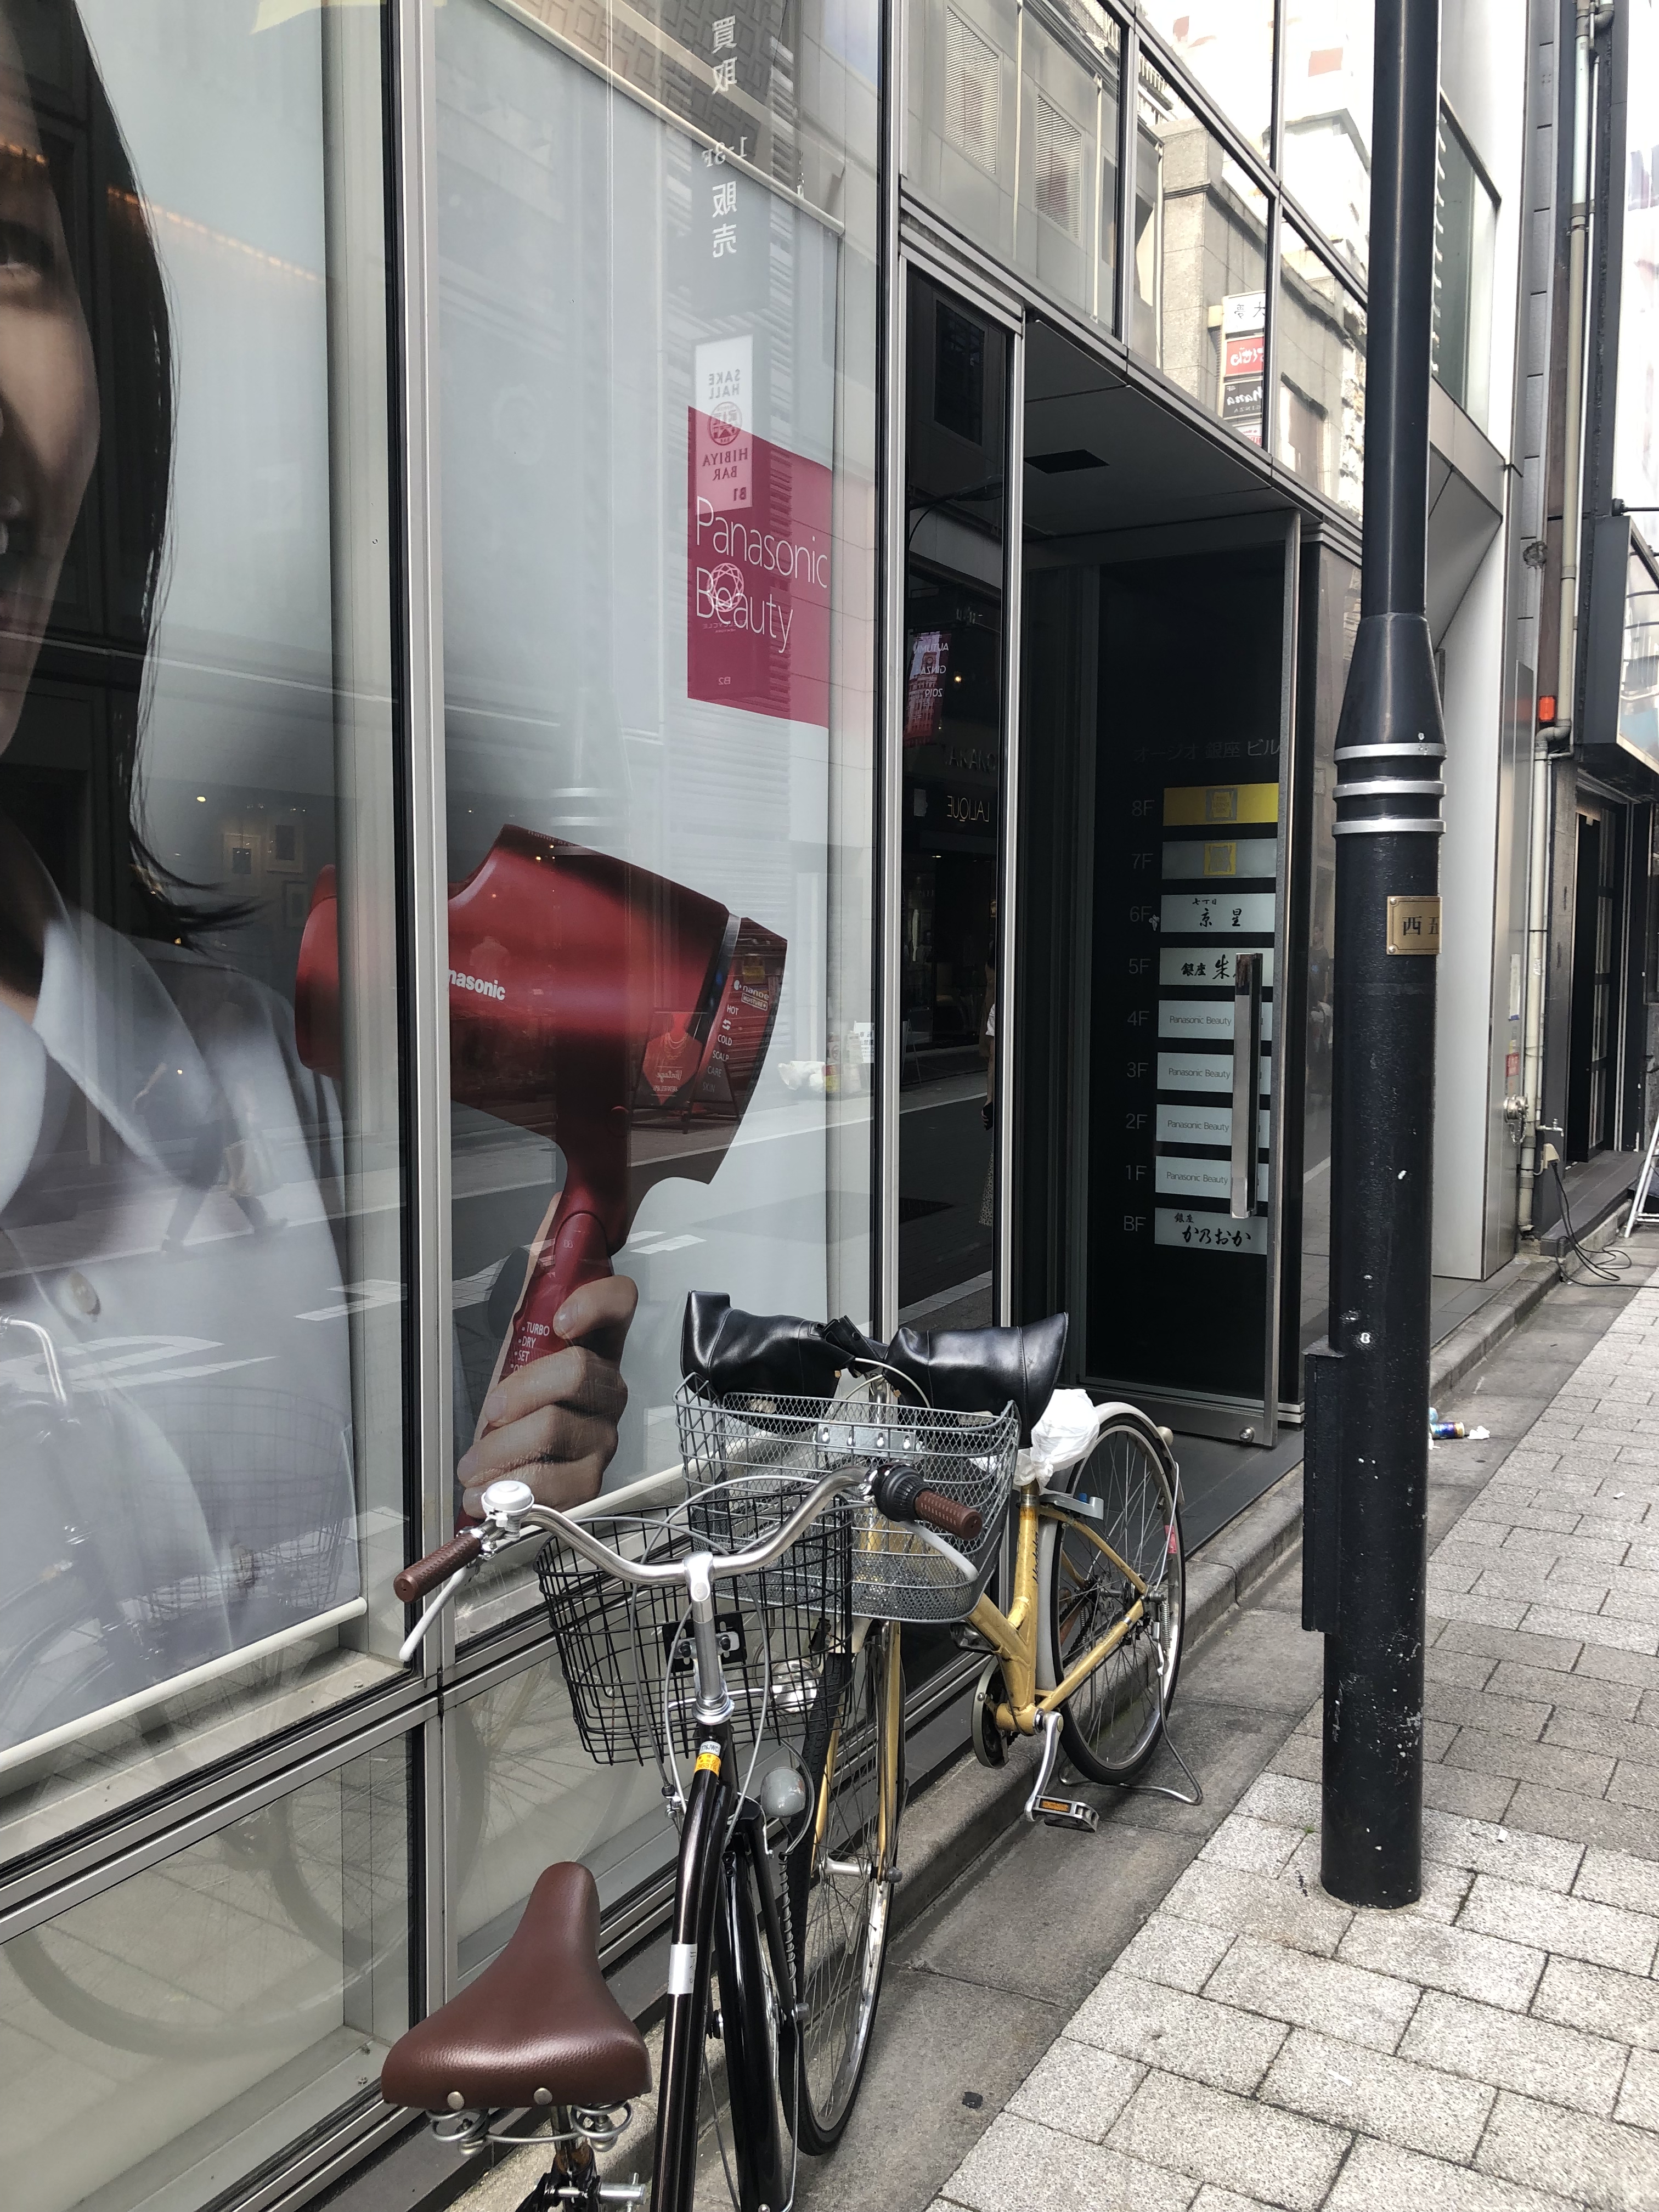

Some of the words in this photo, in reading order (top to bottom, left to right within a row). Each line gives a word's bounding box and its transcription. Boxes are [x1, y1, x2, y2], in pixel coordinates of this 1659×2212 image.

[697, 495, 828, 589] Panasonic
[696, 566, 794, 654] Beauty
[1131, 799, 1155, 817] 8F
[1131, 853, 1154, 870] 7F
[1130, 905, 1152, 923] 6F
[1128, 958, 1152, 974] 5F
[742, 985, 769, 1000] nanoe
[726, 1004, 740, 1015] HOT
[1127, 1010, 1150, 1026] 4F
[1169, 1015, 1204, 1025] Panasonic
[1206, 1016, 1232, 1026] Beauty
[717, 1034, 732, 1046] COLD
[712, 1049, 729, 1062] SCALP
[707, 1065, 723, 1077] CARE
[1126, 1062, 1149, 1079] 3F
[1168, 1068, 1203, 1077] Panasonic
[1205, 1069, 1231, 1080] Beauty
[1126, 1113, 1148, 1130] 2F
[1167, 1120, 1202, 1130] Panasonic
[1204, 1121, 1229, 1132] Beauty
[1126, 1165, 1148, 1181] 1F
[1166, 1172, 1201, 1182] Panasonic
[1203, 1174, 1228, 1186] Beauty
[1124, 1215, 1147, 1232] BF
[526, 1321, 550, 1336] TURBO
[521, 1335, 537, 1349] DRY
[517, 1350, 530, 1362] SET
